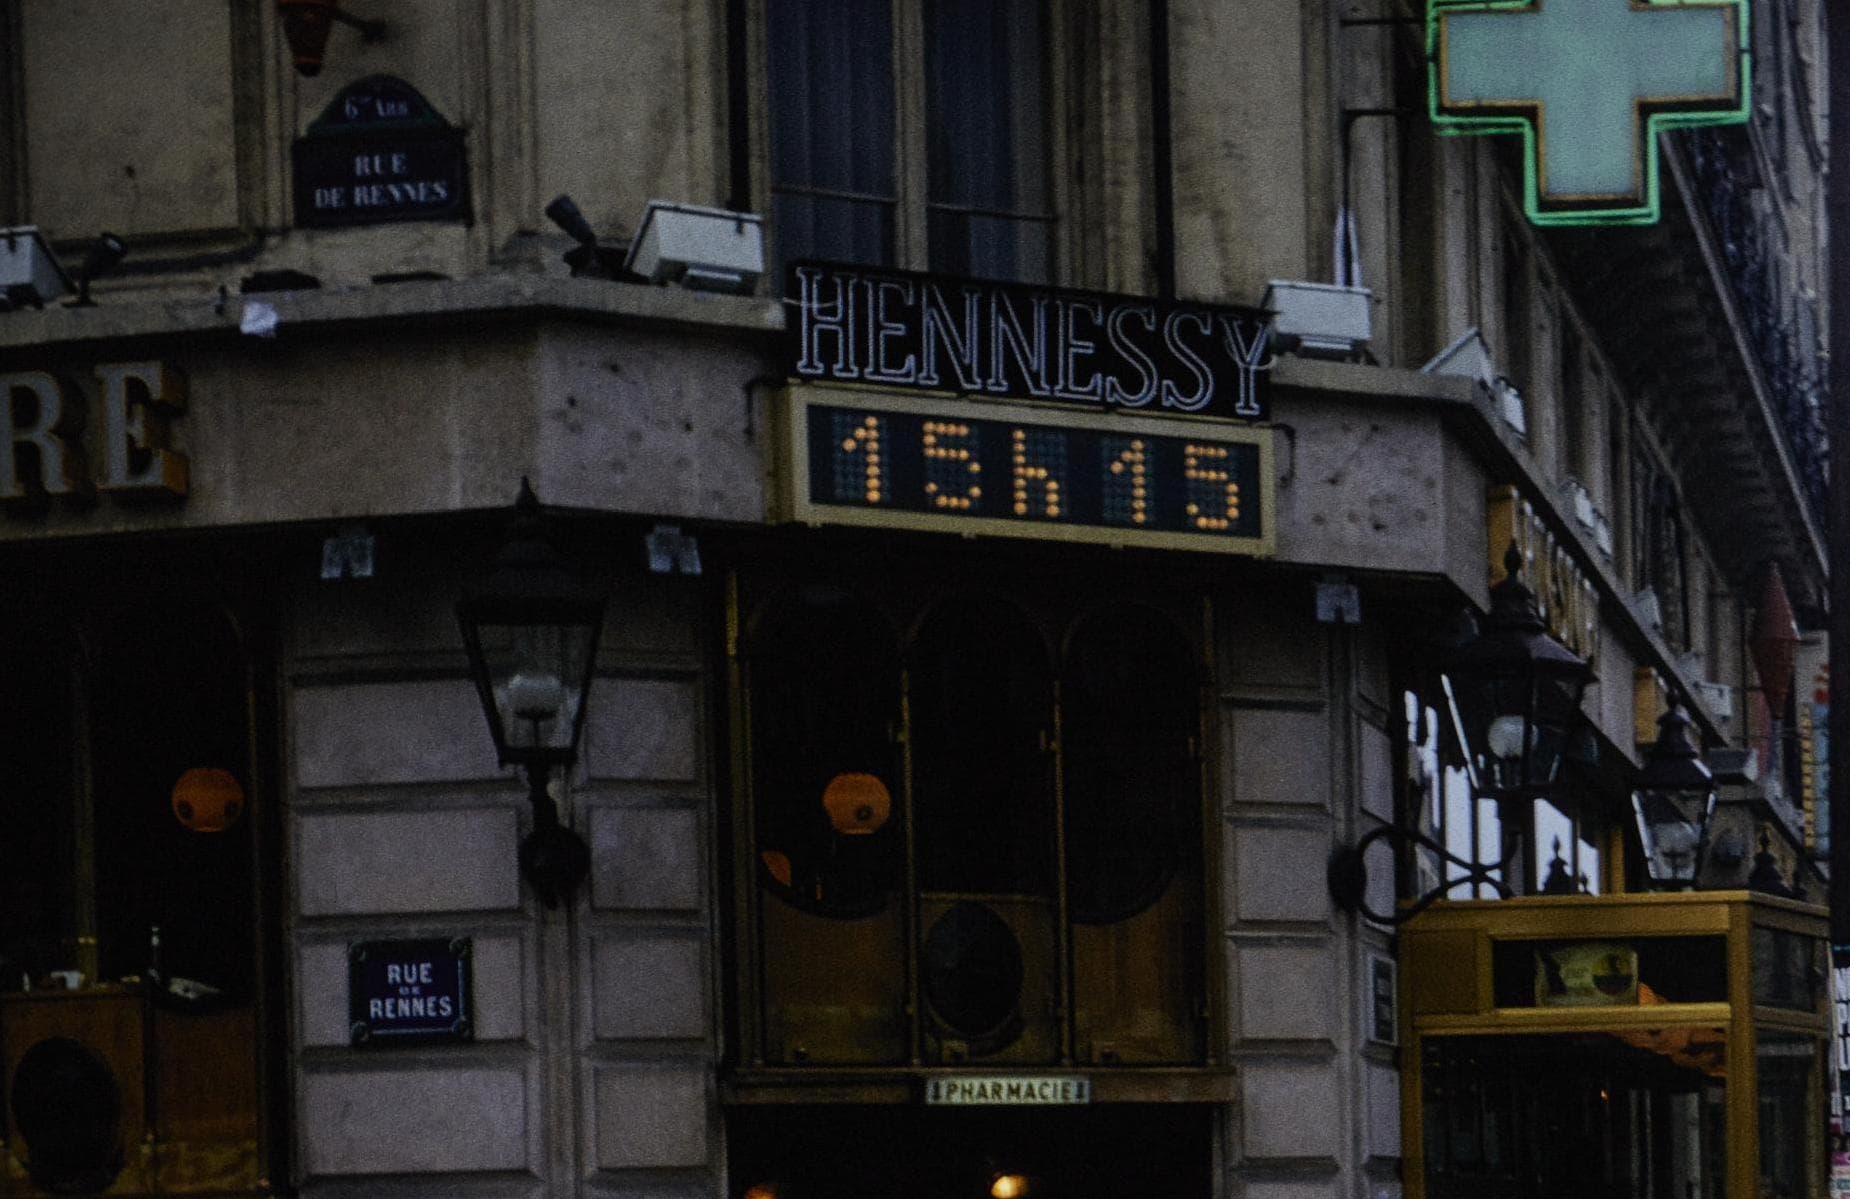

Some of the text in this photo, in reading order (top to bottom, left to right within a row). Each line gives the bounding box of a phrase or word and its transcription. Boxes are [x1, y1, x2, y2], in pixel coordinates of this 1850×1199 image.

[354, 152, 408, 177] RUE
[314, 180, 449, 210] DE RENNES
[796, 266, 1272, 417] HENNESSY
[386, 961, 434, 985] RUE
[369, 995, 453, 1020] RENNES
[945, 1080, 1072, 1102] PHARMACIE
